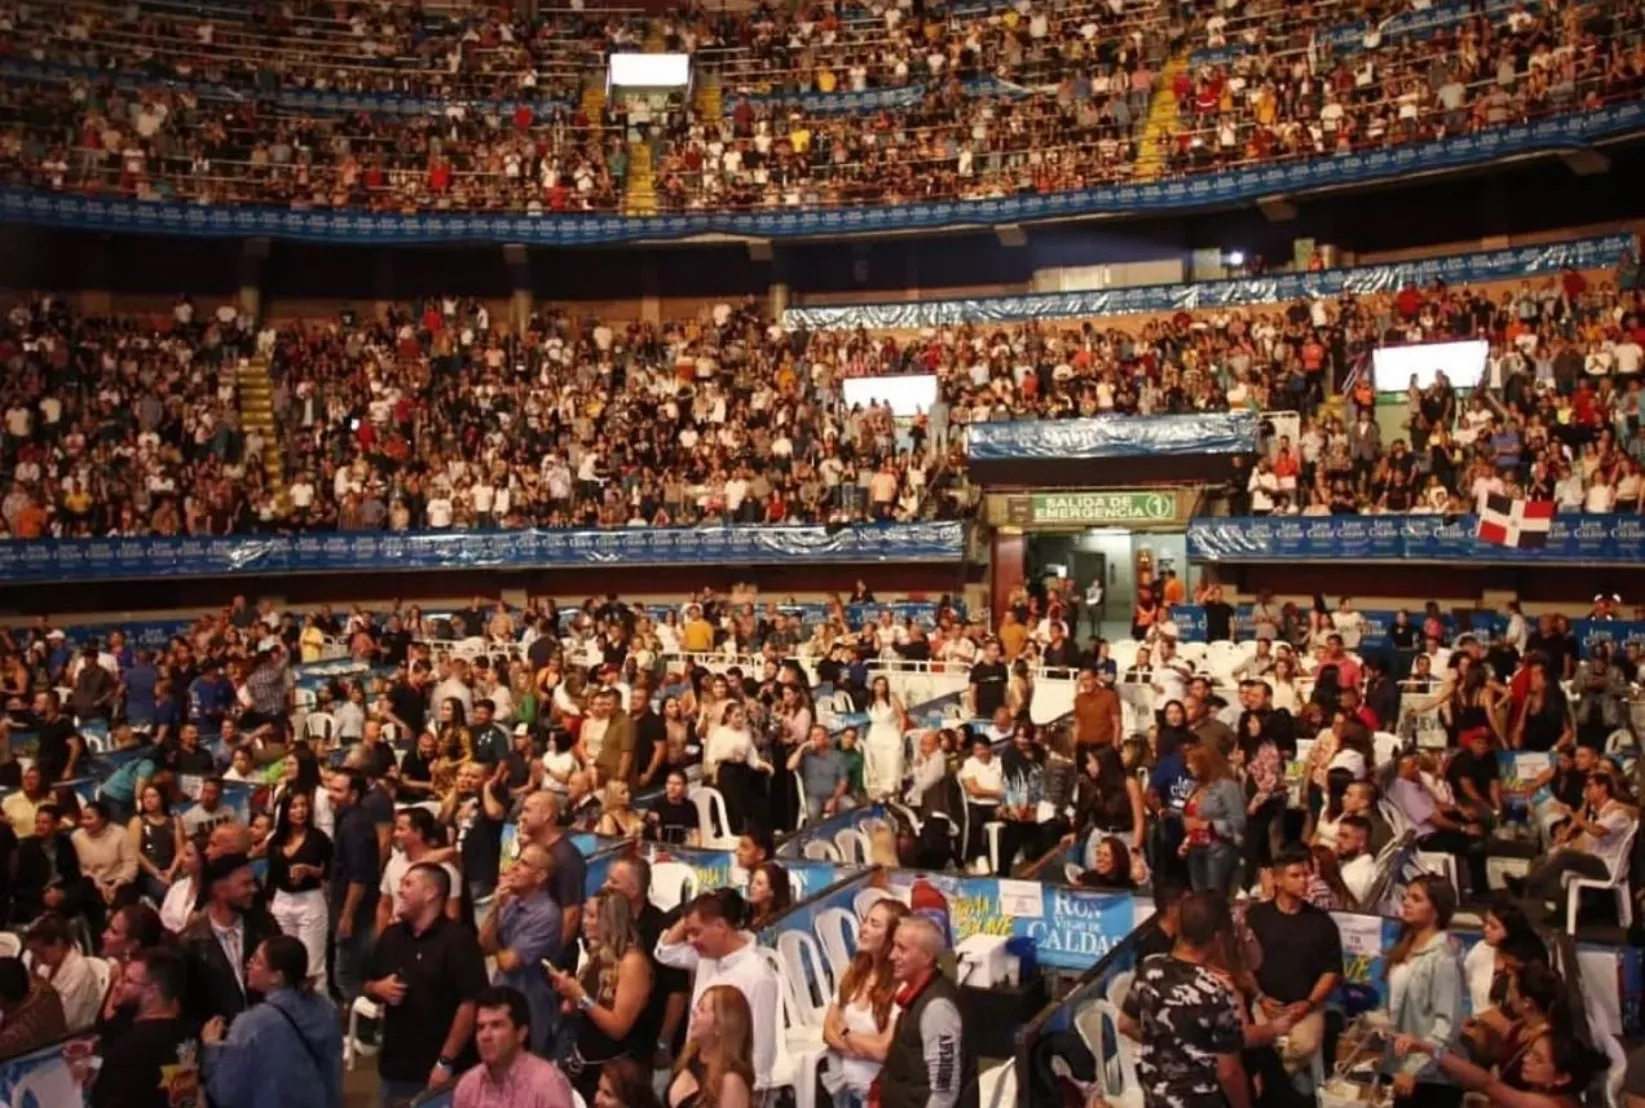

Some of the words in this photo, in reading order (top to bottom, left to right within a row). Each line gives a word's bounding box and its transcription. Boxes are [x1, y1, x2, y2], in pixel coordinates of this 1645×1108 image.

[1047, 496, 1105, 508] SALIDA
[1110, 496, 1132, 508] DE
[1034, 507, 1145, 518] EMERGENCIA
